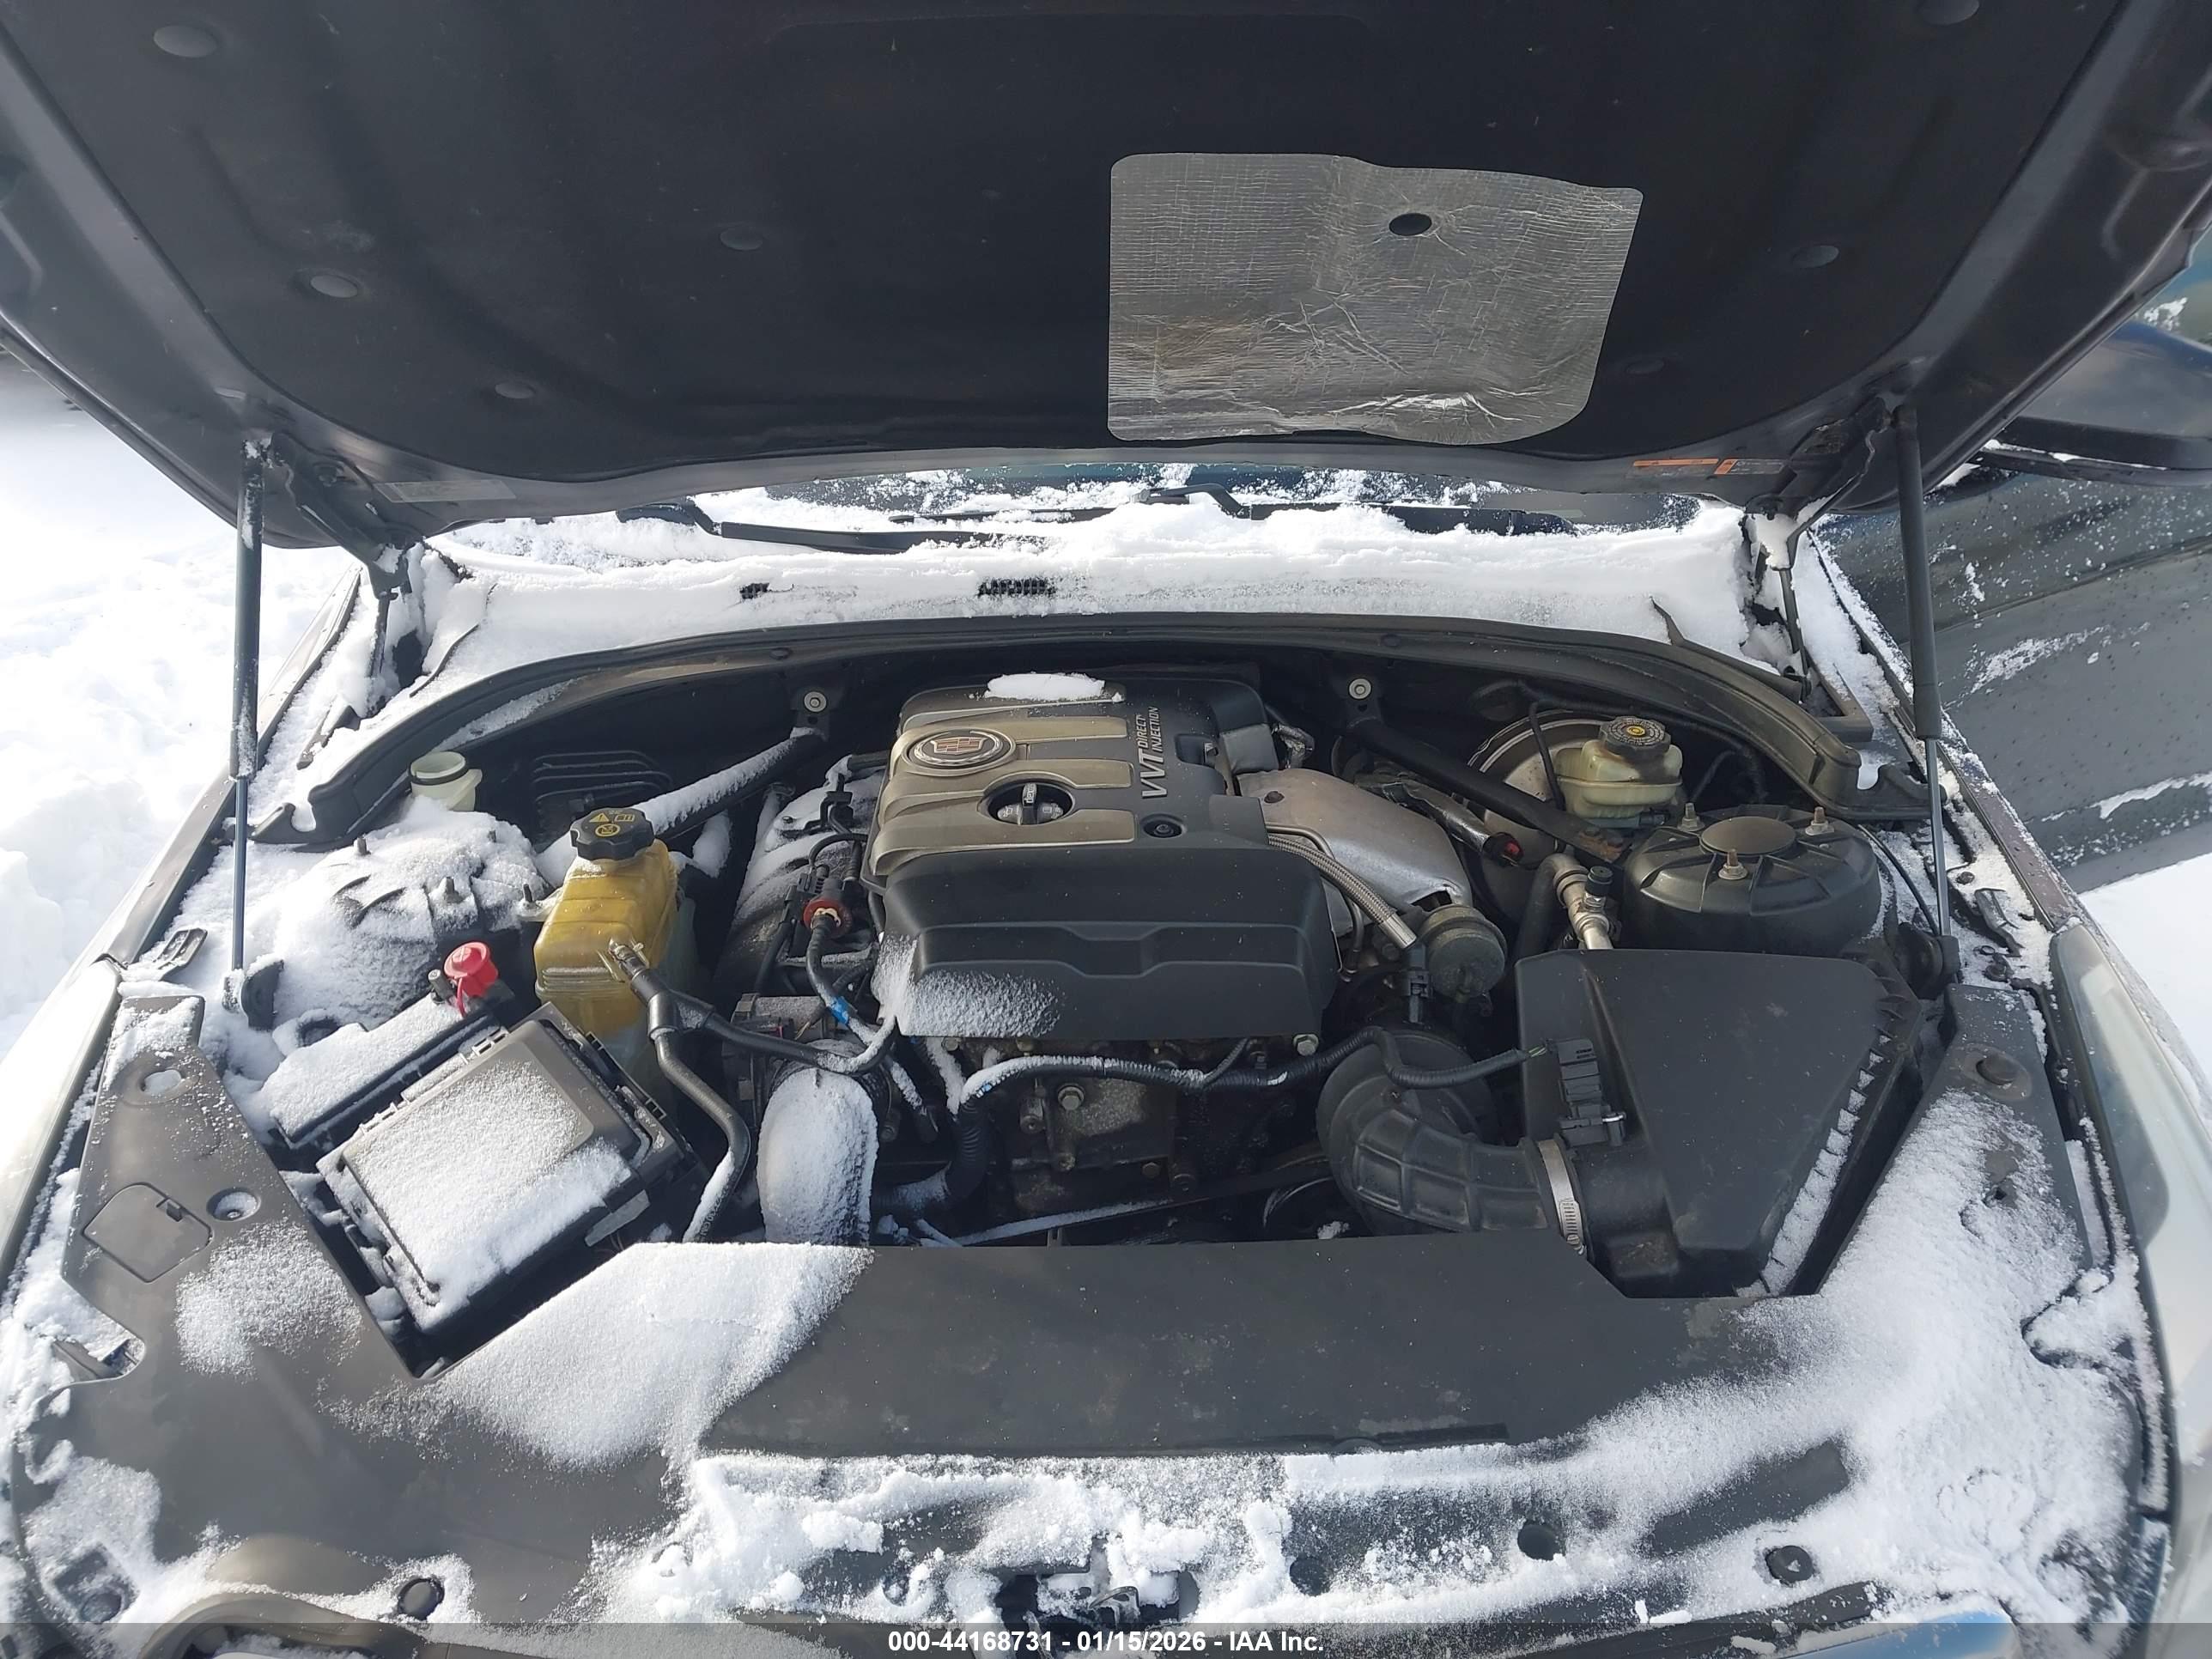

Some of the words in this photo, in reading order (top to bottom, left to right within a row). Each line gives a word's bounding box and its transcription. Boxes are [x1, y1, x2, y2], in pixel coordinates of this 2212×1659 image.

[1136, 714, 1149, 749] DIRECT
[1148, 706, 1163, 752] INJECTION
[1138, 747, 1167, 797] VVT
